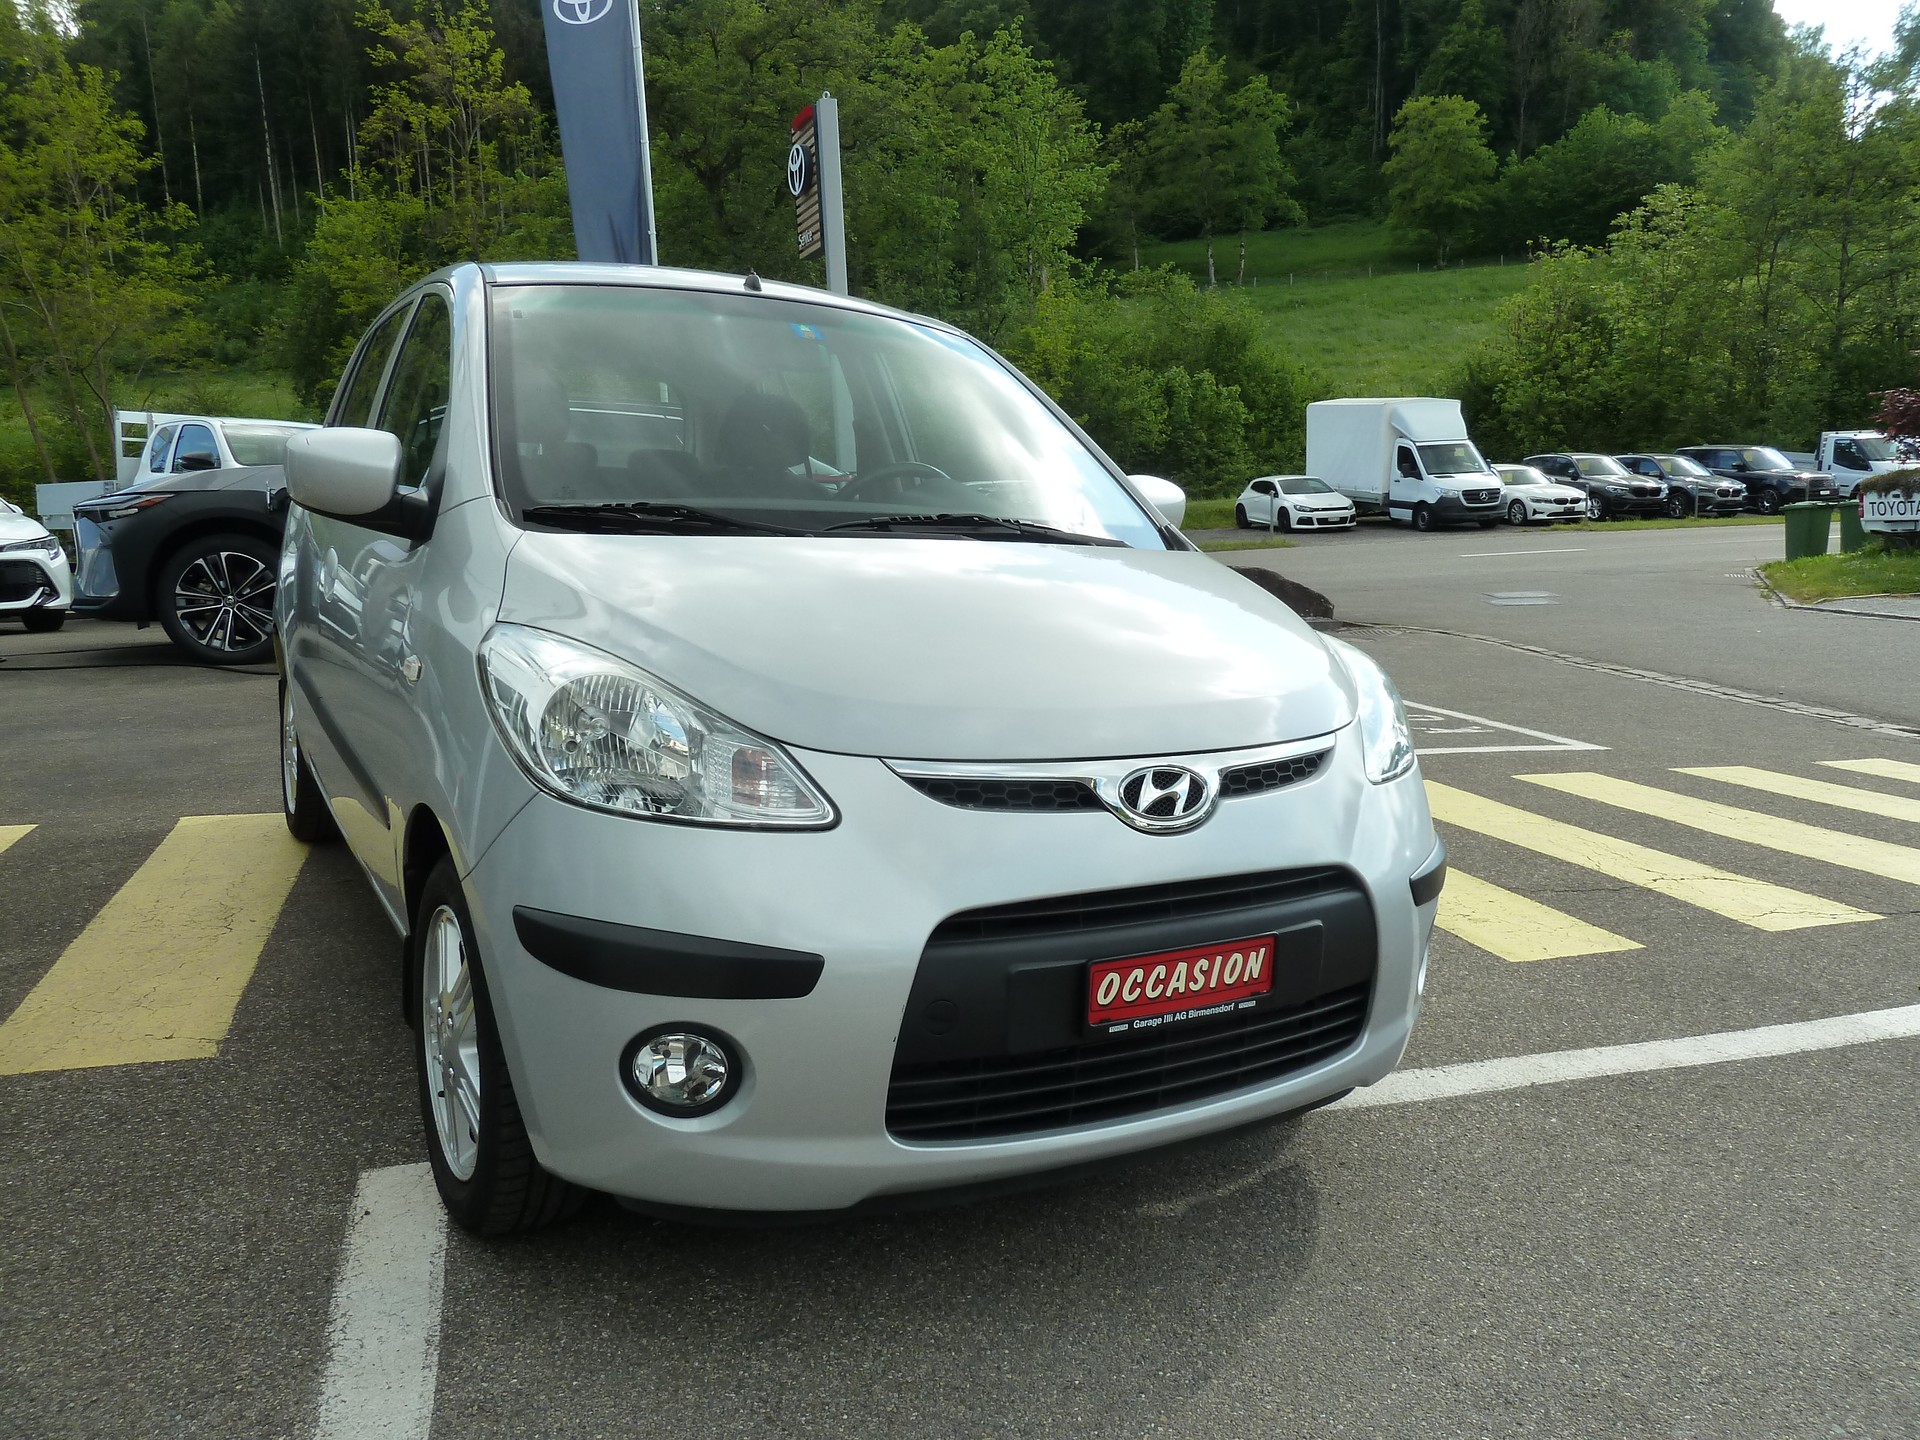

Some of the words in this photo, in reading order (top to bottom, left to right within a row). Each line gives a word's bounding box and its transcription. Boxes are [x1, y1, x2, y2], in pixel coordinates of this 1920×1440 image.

[1097, 948, 1265, 1006] OCCASION
[1133, 1018, 1162, 1029] Garage
[1174, 1011, 1187, 1021] AG
[1188, 1003, 1235, 1018] Birmensdorf
